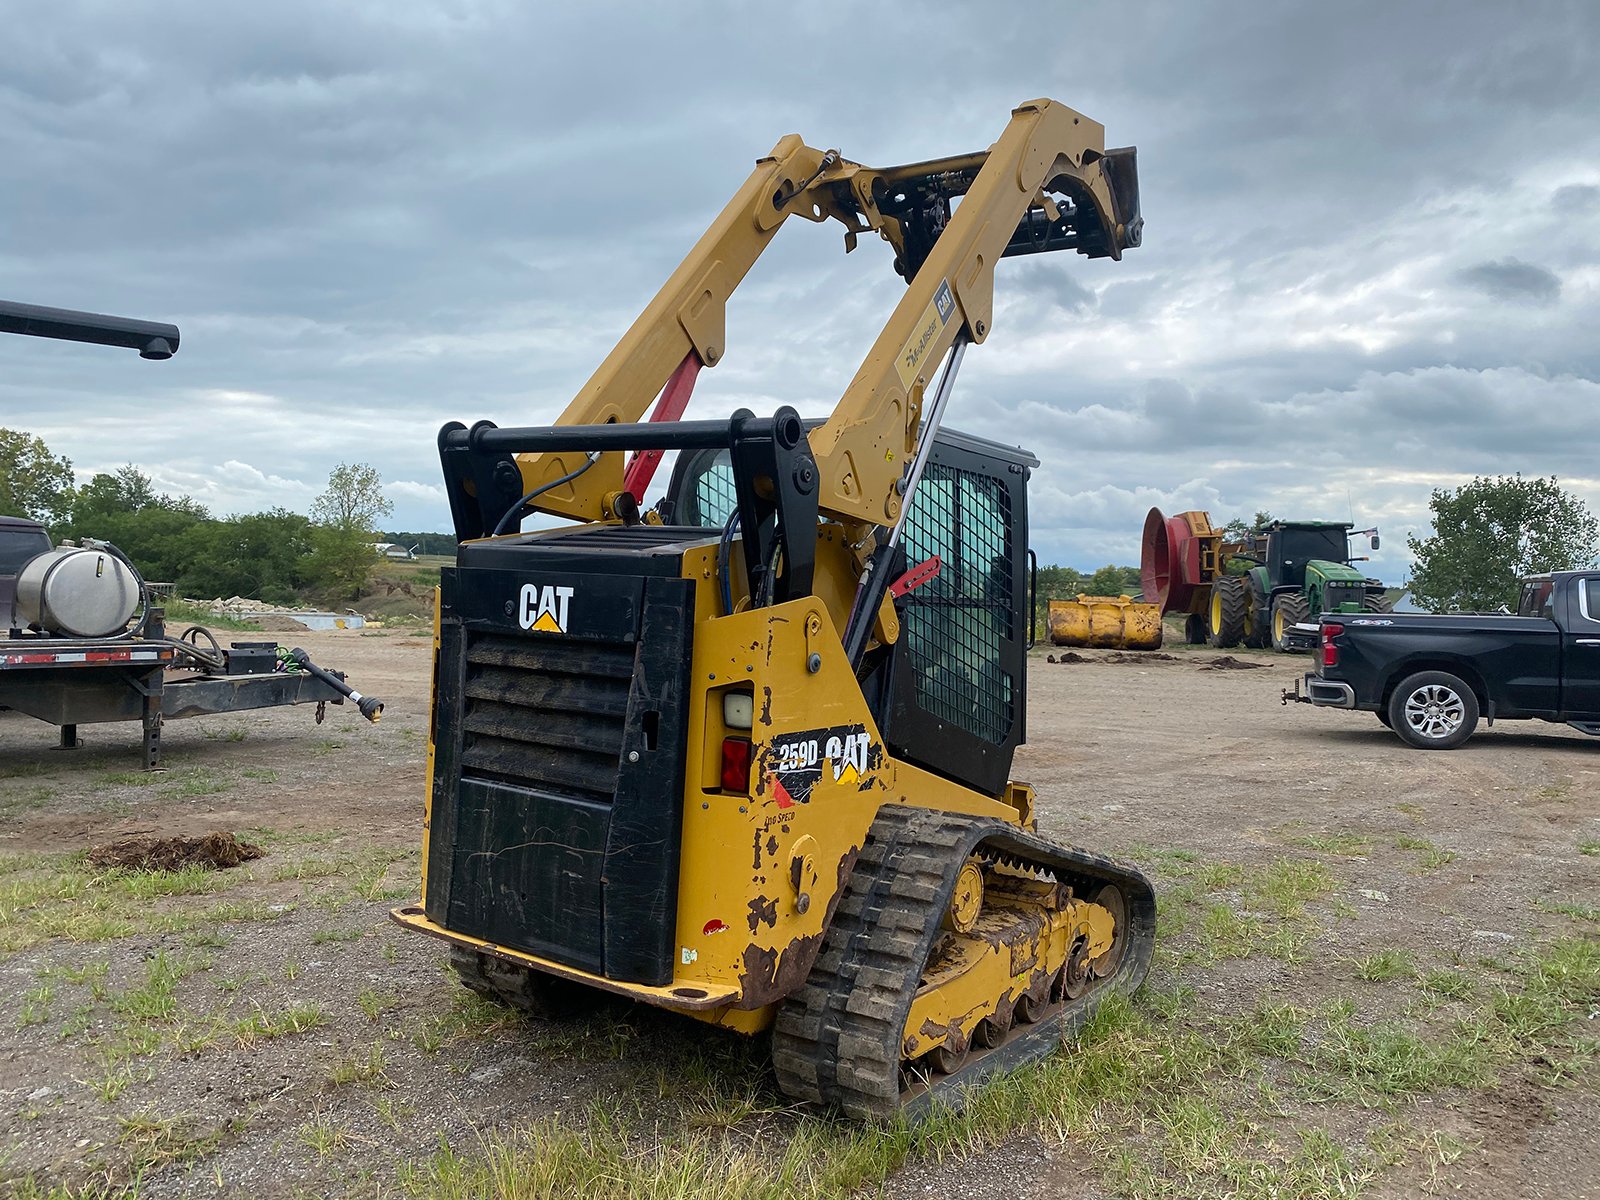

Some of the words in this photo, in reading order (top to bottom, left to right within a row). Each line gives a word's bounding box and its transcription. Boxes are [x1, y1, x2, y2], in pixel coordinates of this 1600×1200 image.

[937, 288, 951, 316] CAT
[519, 583, 574, 633] CAT
[780, 739, 818, 772] 259D
[825, 732, 871, 781] CAT
